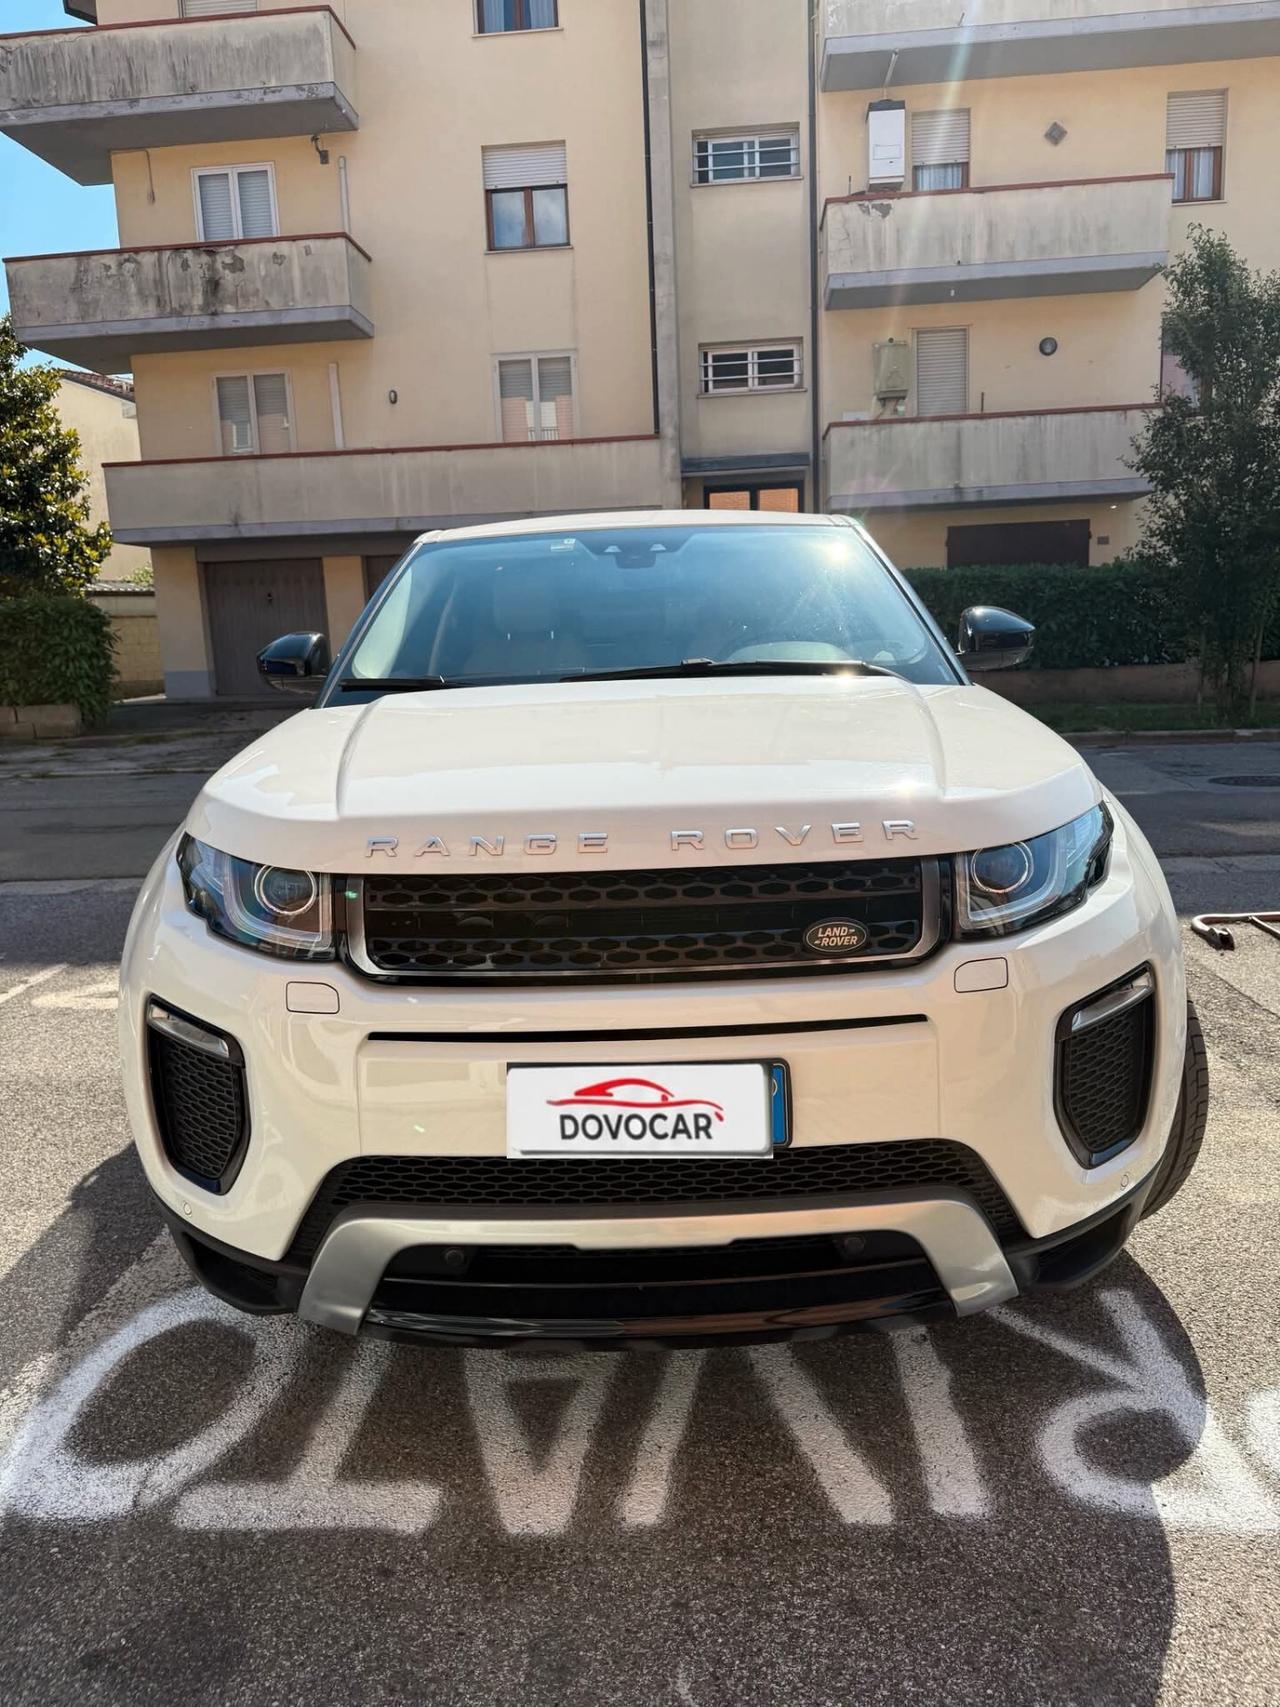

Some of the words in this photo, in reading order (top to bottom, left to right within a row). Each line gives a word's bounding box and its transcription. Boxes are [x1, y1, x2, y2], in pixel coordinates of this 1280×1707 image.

[365, 832, 608, 857] RANGE
[670, 819, 919, 851] ROVER
[818, 927, 848, 937] LAND
[821, 936, 858, 946] ROVER
